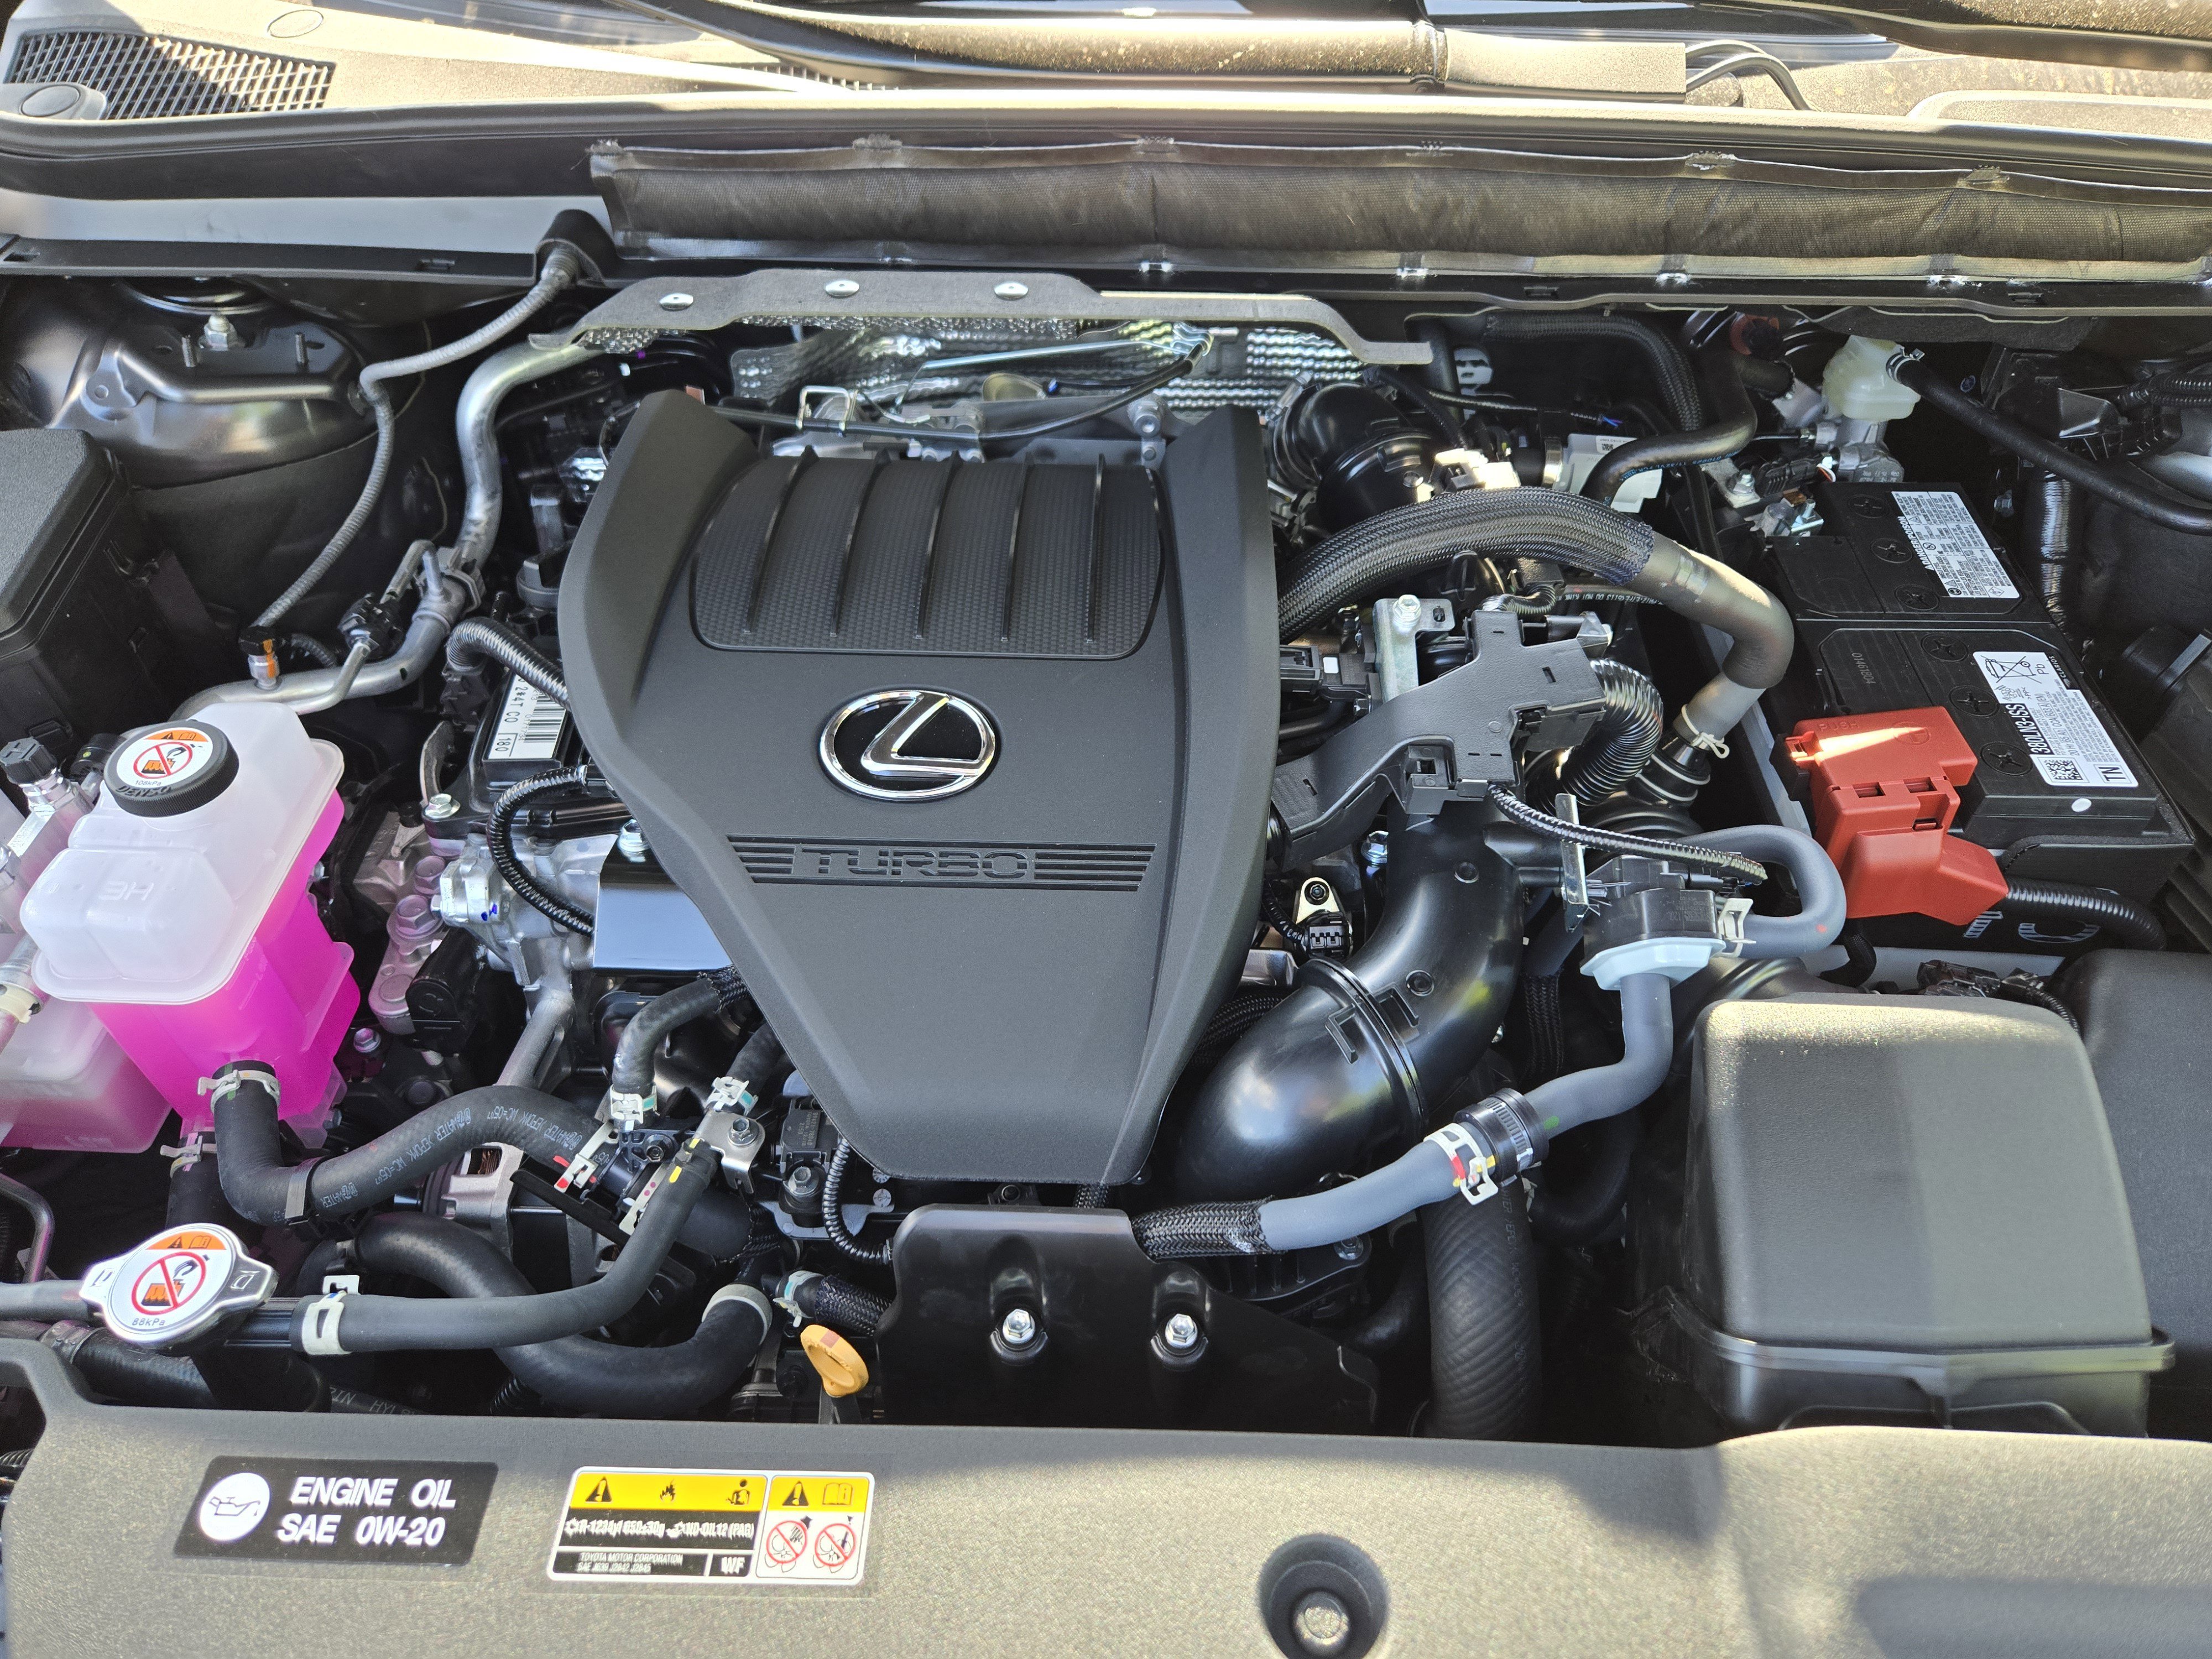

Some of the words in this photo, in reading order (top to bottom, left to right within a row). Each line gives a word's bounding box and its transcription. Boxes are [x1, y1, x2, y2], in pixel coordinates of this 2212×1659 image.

[1896, 516, 1932, 564] DANGER/POISON
[2033, 664, 2049, 674] Pb
[2048, 655, 2067, 677] CLARIOS
[2004, 704, 2052, 753] 380LN3-ISS
[494, 737, 512, 752] 180
[2098, 766, 2127, 781] TN
[115, 785, 171, 797] DENSO
[801, 847, 1029, 879] TURBO
[132, 1317, 166, 1326] 88kPa
[290, 1477, 398, 1507] ENGINE
[411, 1479, 456, 1509] OIL
[276, 1513, 341, 1543] SAE
[355, 1515, 446, 1547] 0W-20
[728, 1522, 755, 1540] (PAG)
[577, 1562, 592, 1573] SAE
[592, 1562, 609, 1573] J639
[609, 1563, 630, 1574] J2842
[630, 1563, 652, 1574] J2845
[580, 1552, 607, 1562] TOYOTA
[608, 1552, 634, 1563] MOTOR
[634, 1553, 684, 1567] CORPORATION
[721, 1557, 745, 1574] WF
